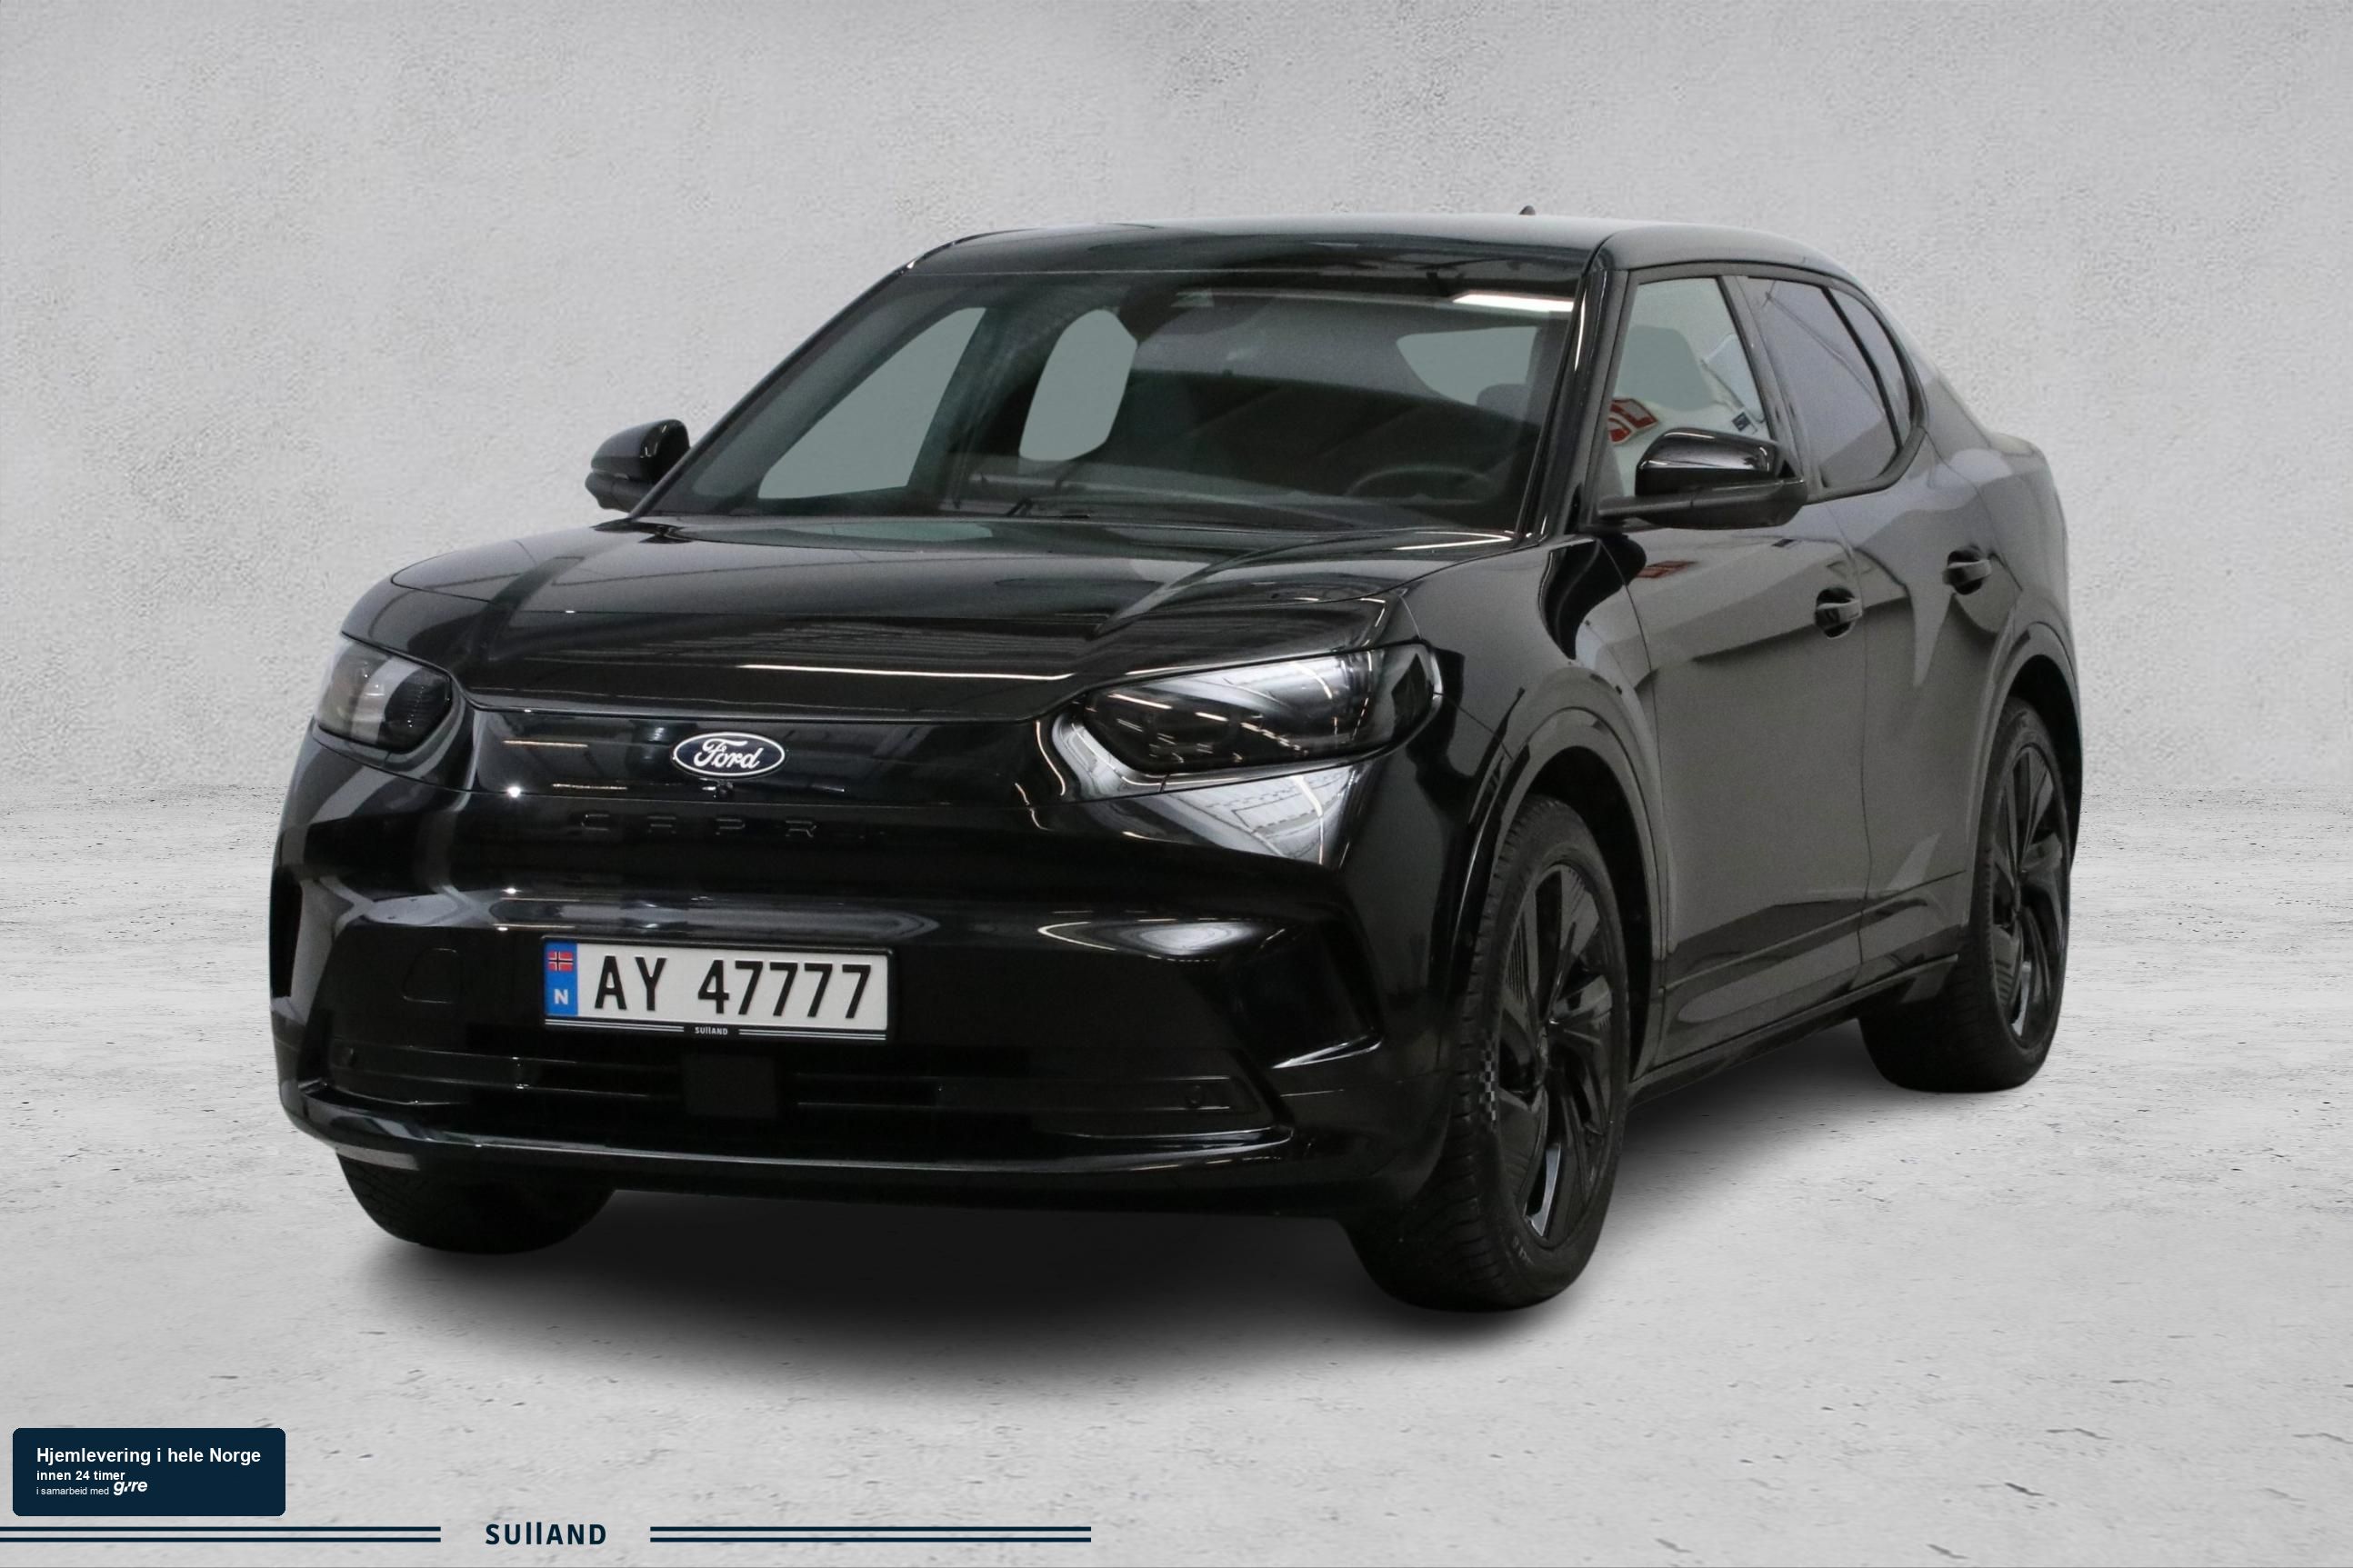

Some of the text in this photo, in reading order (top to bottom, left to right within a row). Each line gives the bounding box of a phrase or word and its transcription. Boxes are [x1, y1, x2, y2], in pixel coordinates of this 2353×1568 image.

[694, 738, 763, 769] Ford
[554, 988, 569, 1005] N
[594, 955, 873, 1019] AY 47777
